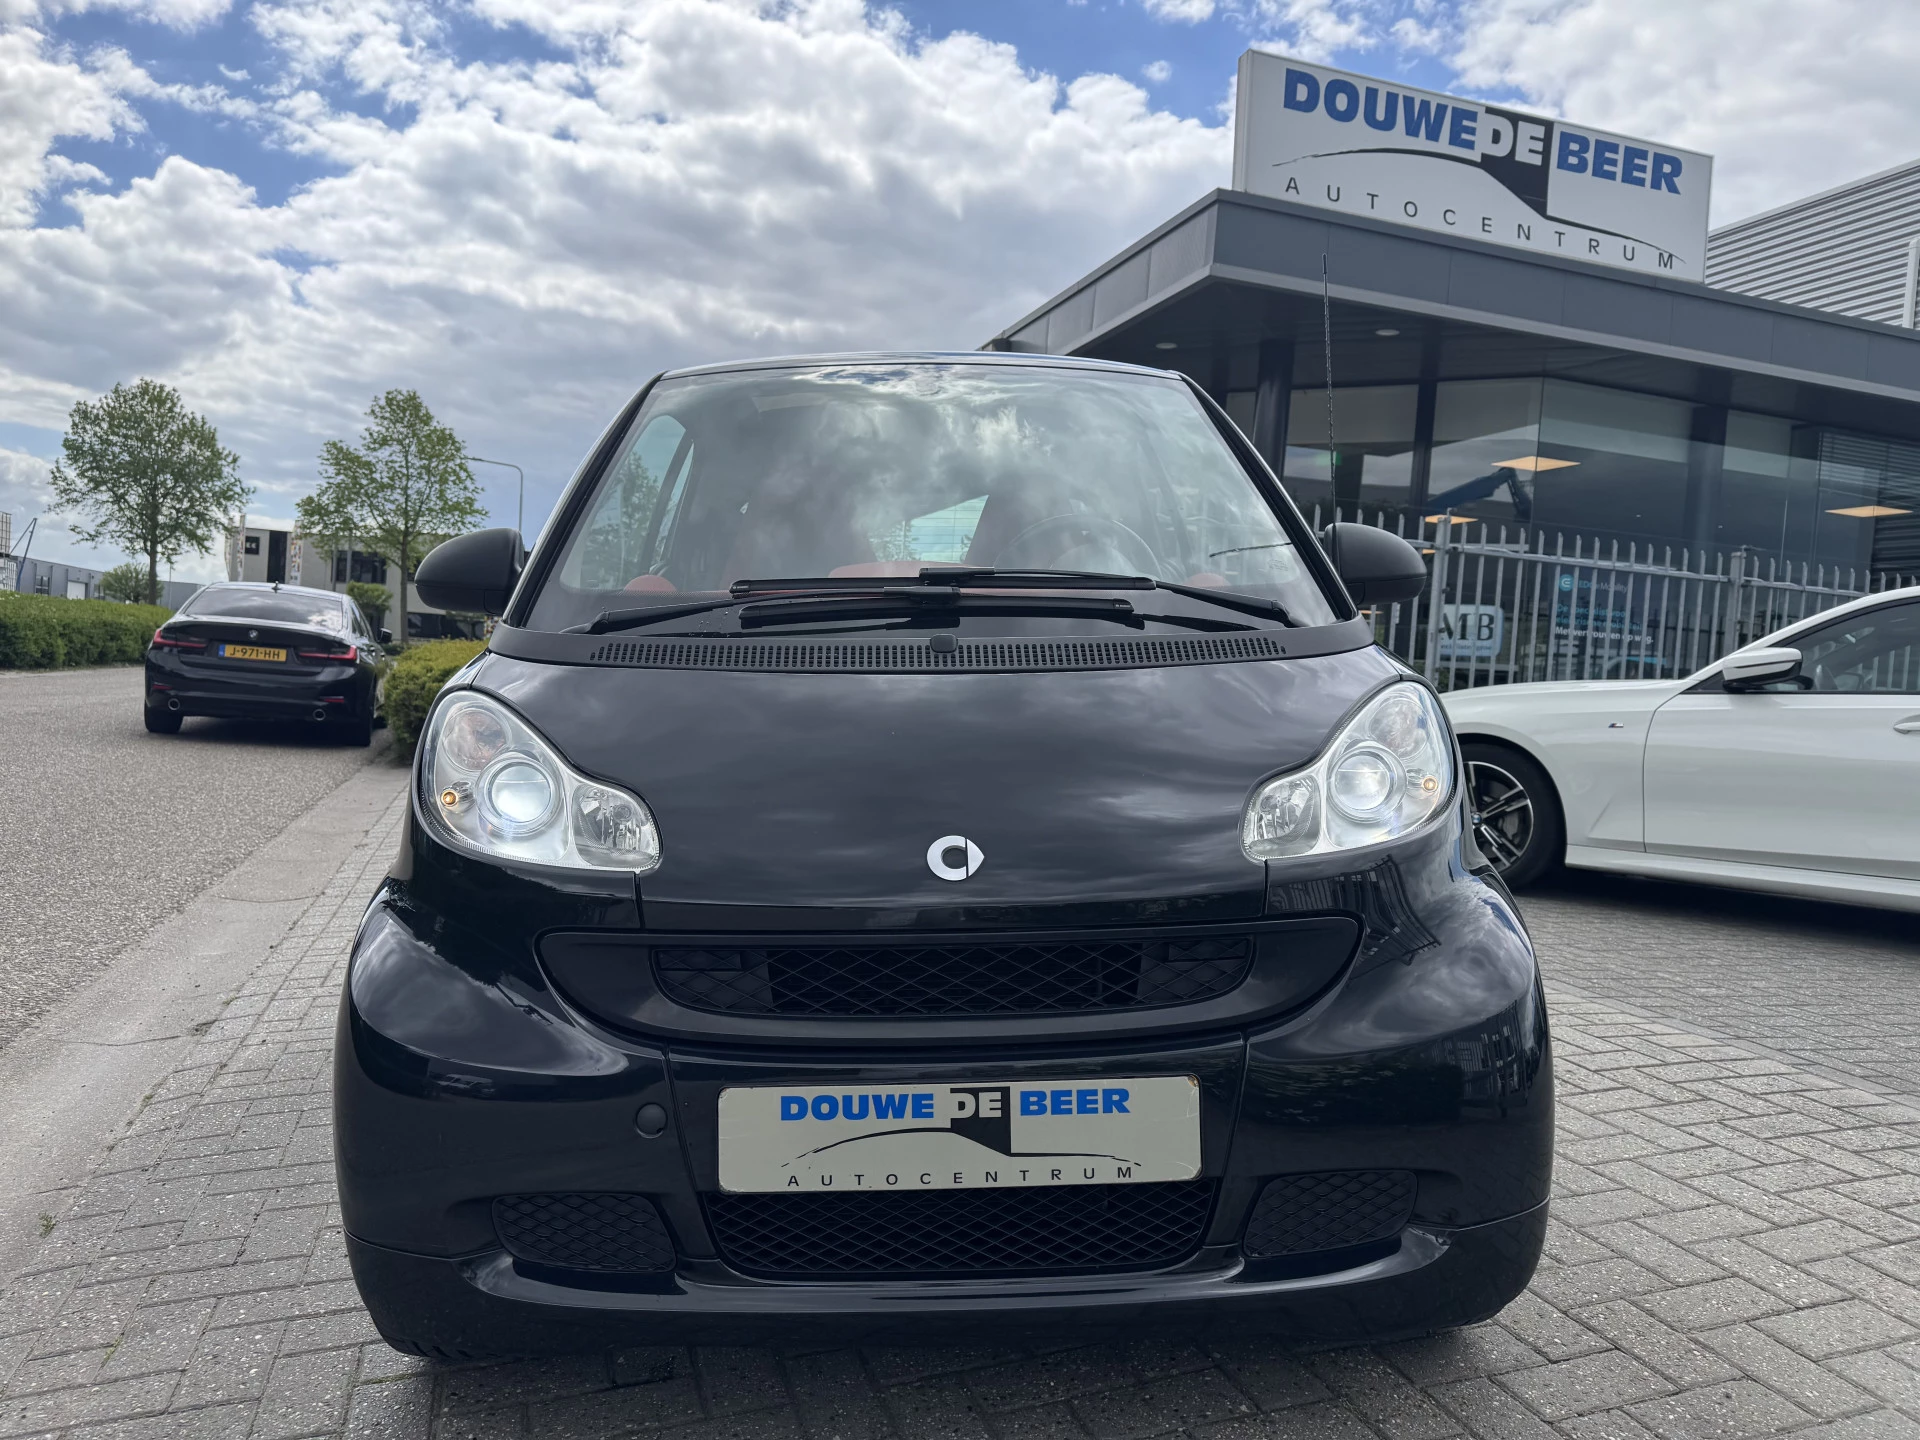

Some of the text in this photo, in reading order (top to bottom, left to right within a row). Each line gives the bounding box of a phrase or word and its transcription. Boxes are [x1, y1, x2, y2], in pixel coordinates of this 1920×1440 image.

[1283, 67, 1683, 195] DOUWE DE BEER
[1285, 177, 1673, 270] AUTOCENTRUM
[1570, 606, 1609, 617] peclist
[1574, 629, 1621, 641] verouen
[1635, 634, 1654, 645] wg.
[230, 647, 280, 659] J-971-HH
[780, 1088, 1131, 1122] DOUWE DE BEER
[787, 1166, 1133, 1187] AUTOCENTRUM
